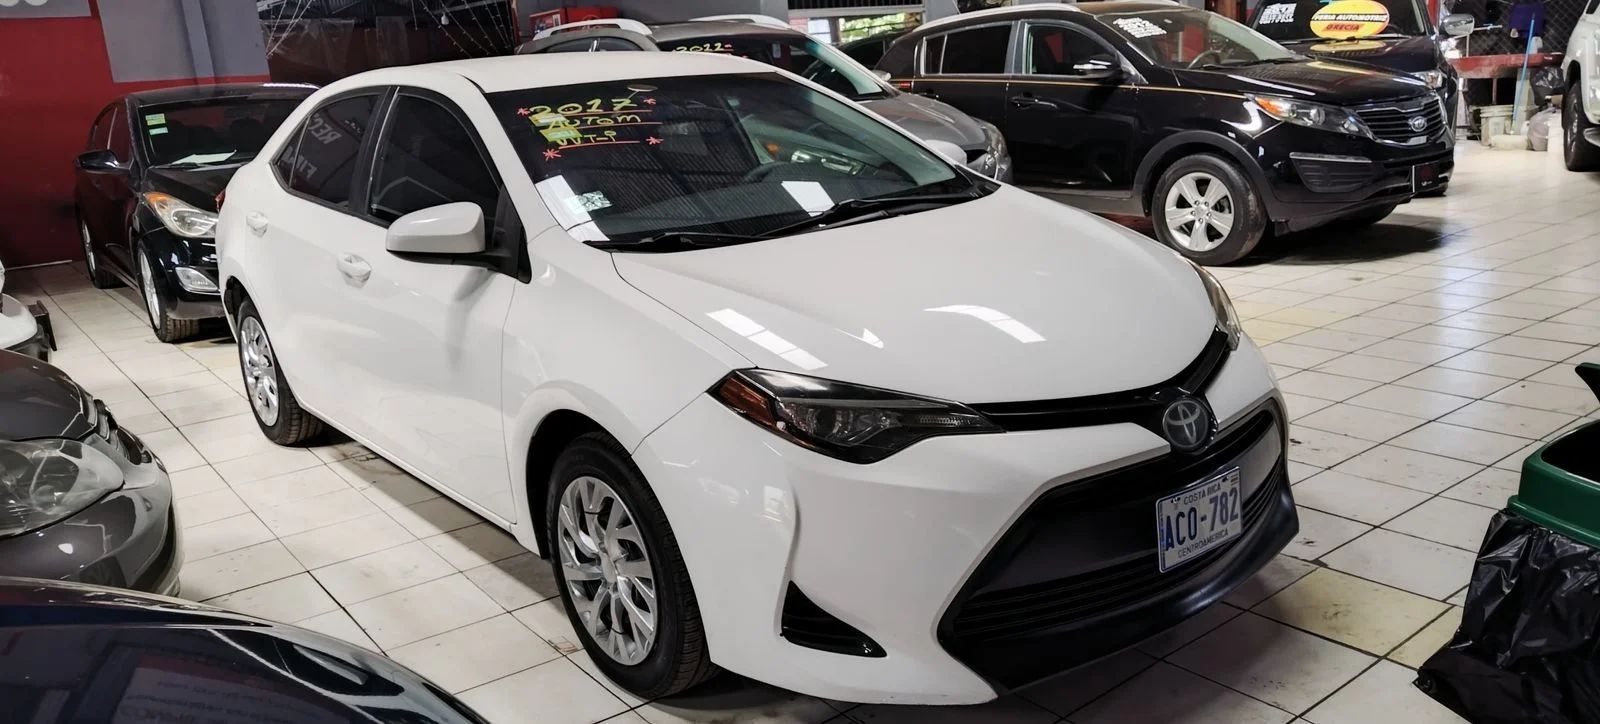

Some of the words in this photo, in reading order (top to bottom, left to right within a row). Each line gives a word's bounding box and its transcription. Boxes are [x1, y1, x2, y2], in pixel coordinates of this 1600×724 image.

[529, 99, 637, 119] 2017
[1184, 489, 1206, 505] COSTA
[1206, 482, 1221, 497] RICA
[1178, 527, 1229, 558] CENTROAMERICA
